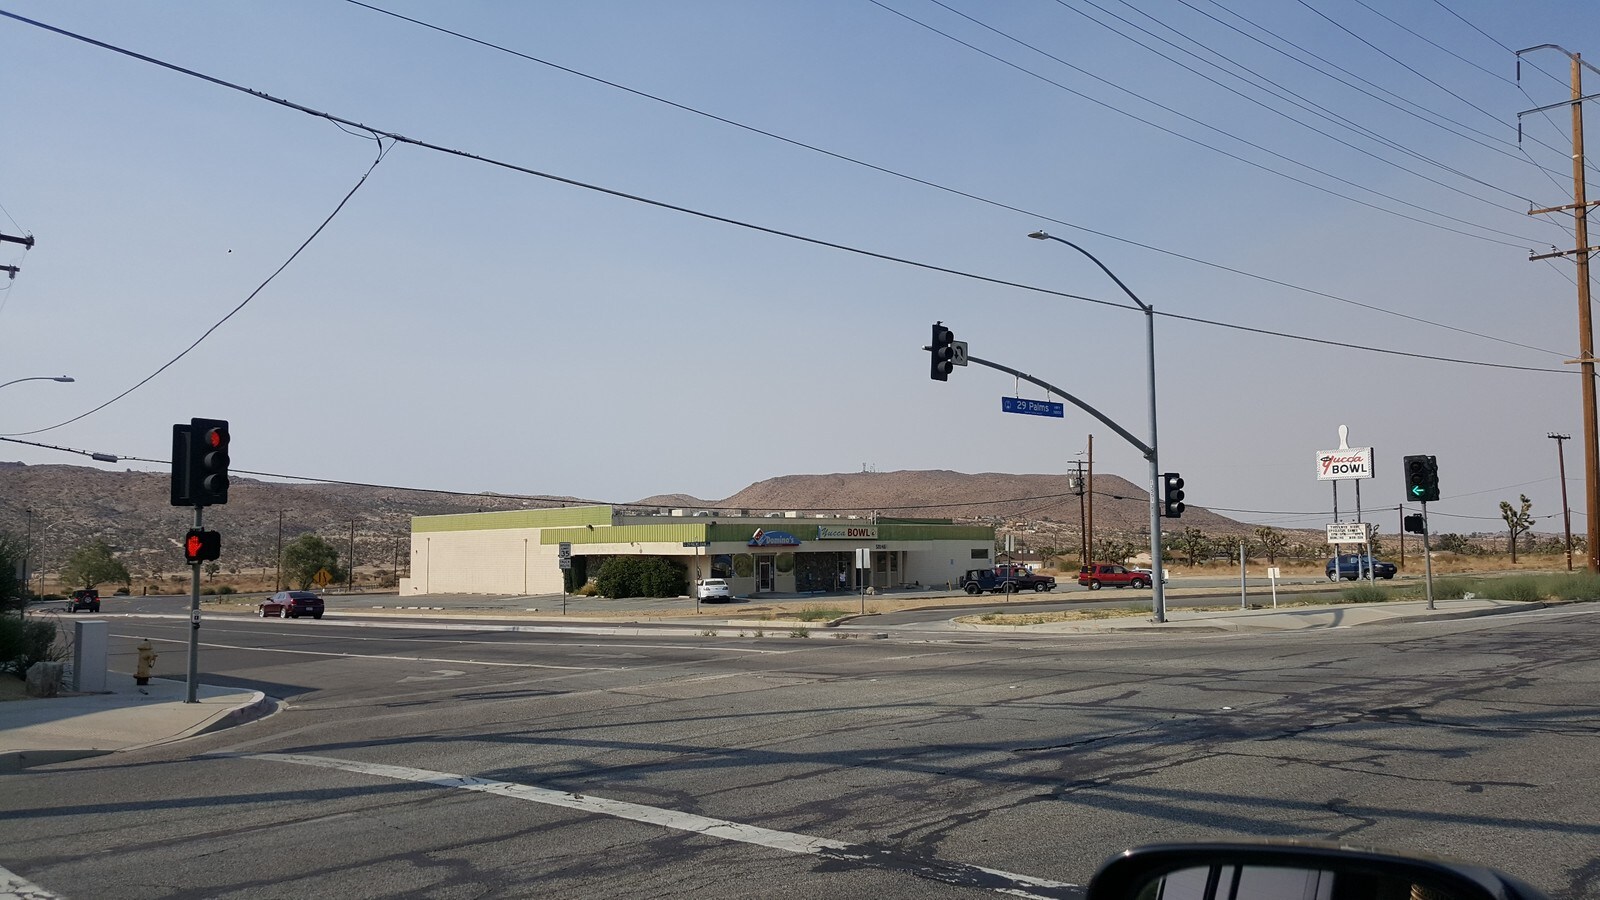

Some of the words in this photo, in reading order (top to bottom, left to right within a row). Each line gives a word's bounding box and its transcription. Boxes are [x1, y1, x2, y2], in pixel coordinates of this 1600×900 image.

[1016, 400, 1027, 410] 29
[1029, 402, 1050, 412] Palms
[1320, 455, 1364, 475] Yucca
[1332, 464, 1367, 474] BOWL
[821, 527, 846, 537] Yucca
[847, 528, 871, 537] BOWL
[765, 535, 795, 545] Domino's
